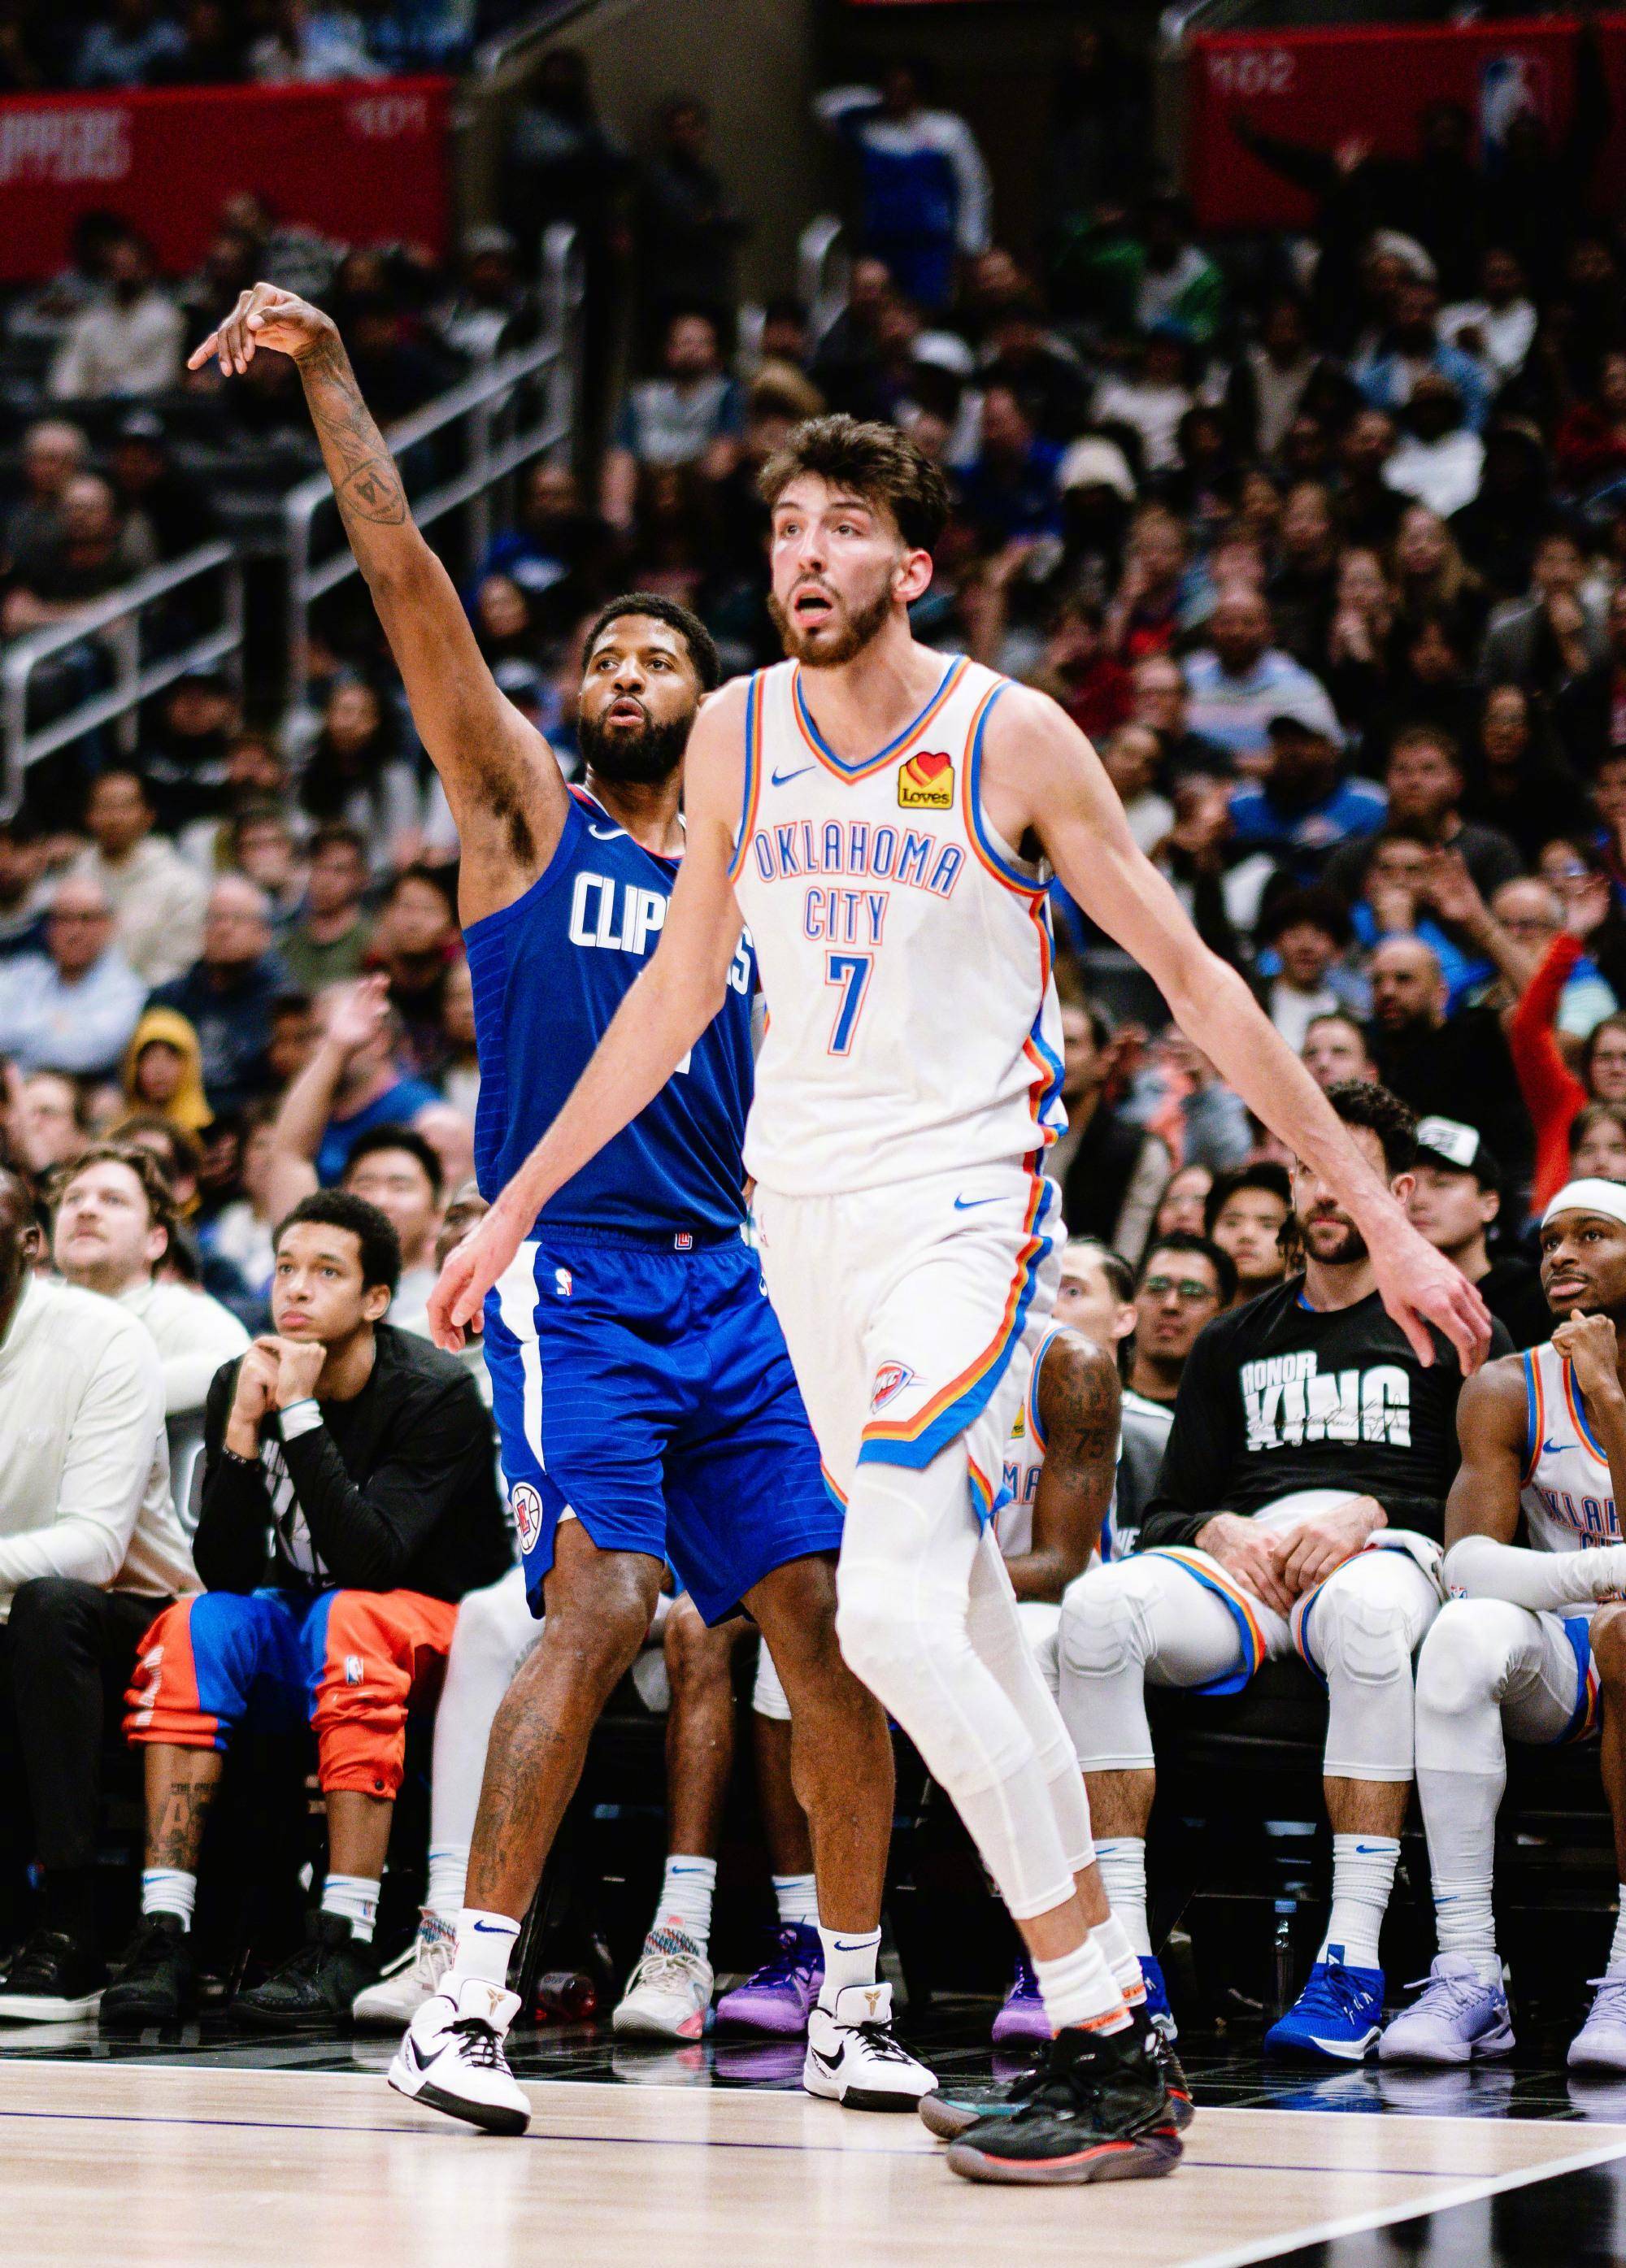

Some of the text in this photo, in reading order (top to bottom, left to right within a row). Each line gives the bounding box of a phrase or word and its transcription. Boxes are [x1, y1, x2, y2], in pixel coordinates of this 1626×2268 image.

[1209, 50, 1293, 92] 102
[753, 819, 967, 900] OKLAHOMA
[569, 871, 754, 995] CLIPS
[802, 886, 890, 945] CITY
[824, 949, 875, 1057] 7
[1241, 1351, 1317, 1397] HONOR
[1243, 1365, 1411, 1451] KING
